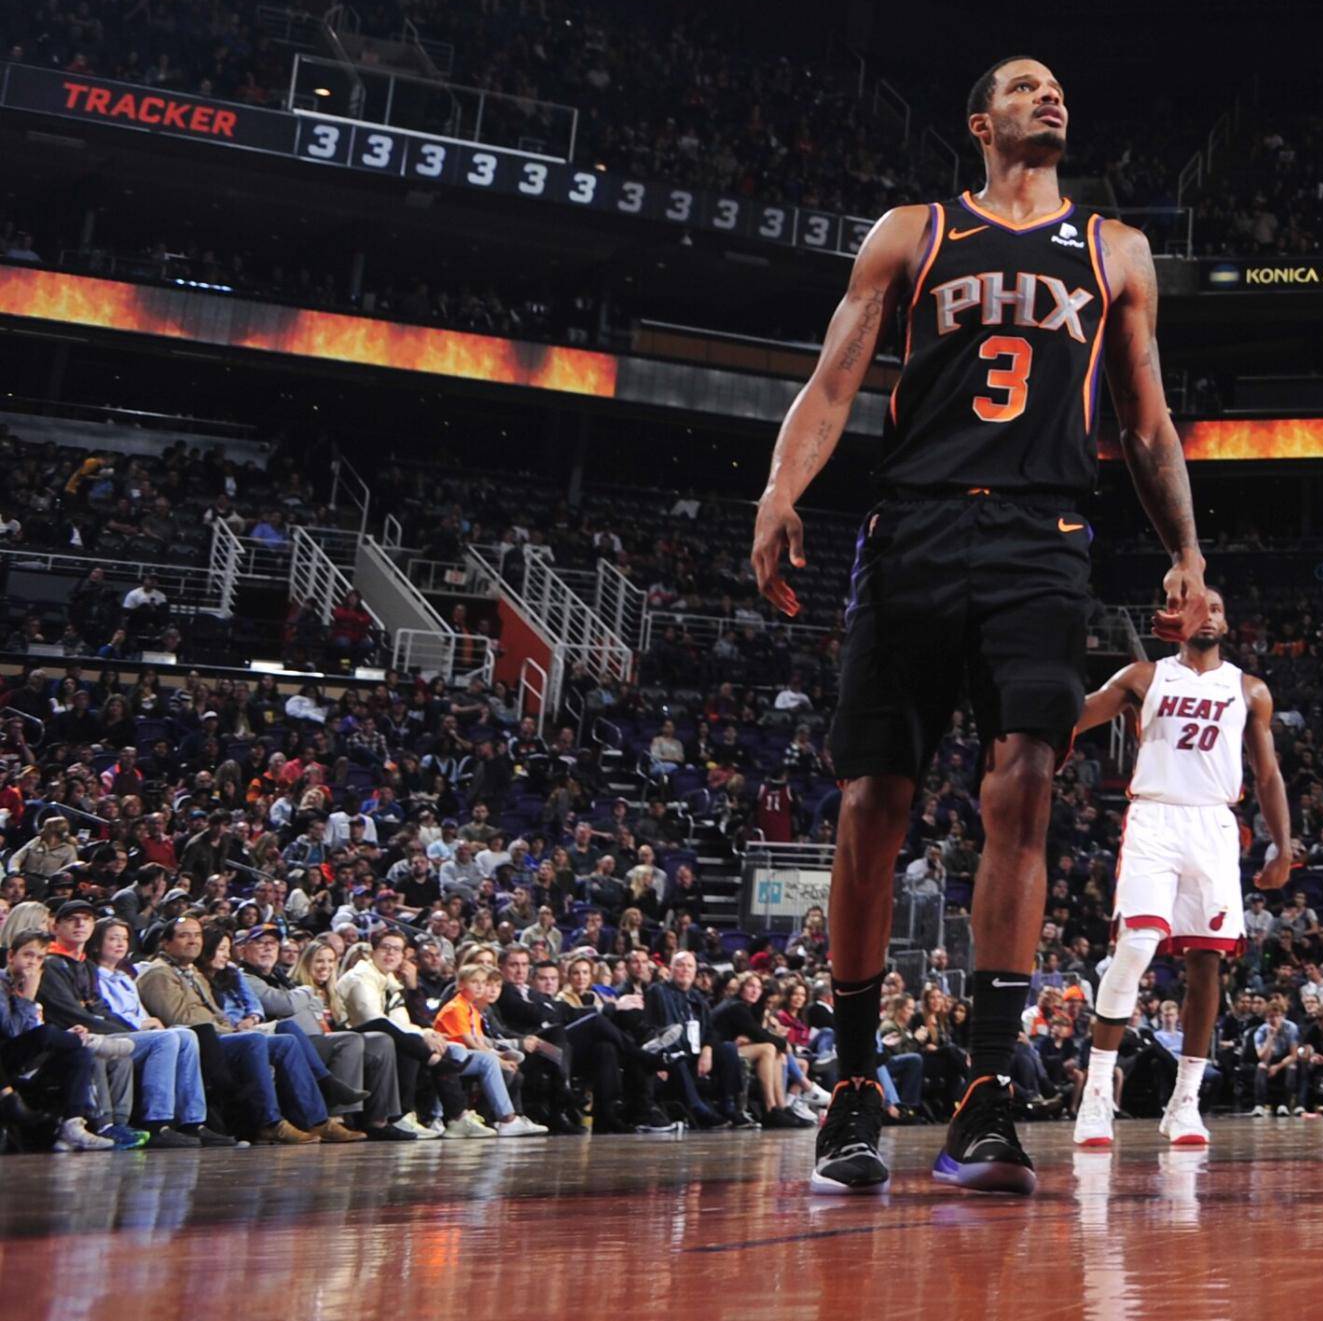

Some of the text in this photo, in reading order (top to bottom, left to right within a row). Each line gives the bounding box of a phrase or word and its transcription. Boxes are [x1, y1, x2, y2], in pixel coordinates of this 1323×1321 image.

[63, 82, 238, 138] TRACKER
[307, 124, 340, 159] 3
[361, 134, 394, 168] 3
[415, 144, 447, 178] 3
[467, 153, 498, 187] 3
[518, 162, 548, 196] 3
[568, 171, 598, 205] 3
[617, 181, 646, 214] 3
[665, 190, 694, 222] 3
[712, 199, 740, 231] 3
[758, 207, 786, 239] 3
[803, 215, 830, 247] 3
[1246, 267, 1320, 285] KONICA
[929, 271, 1095, 344] PHX
[972, 335, 1034, 423] 3
[1156, 695, 1236, 722] HEAT
[1175, 722, 1220, 752] 20
